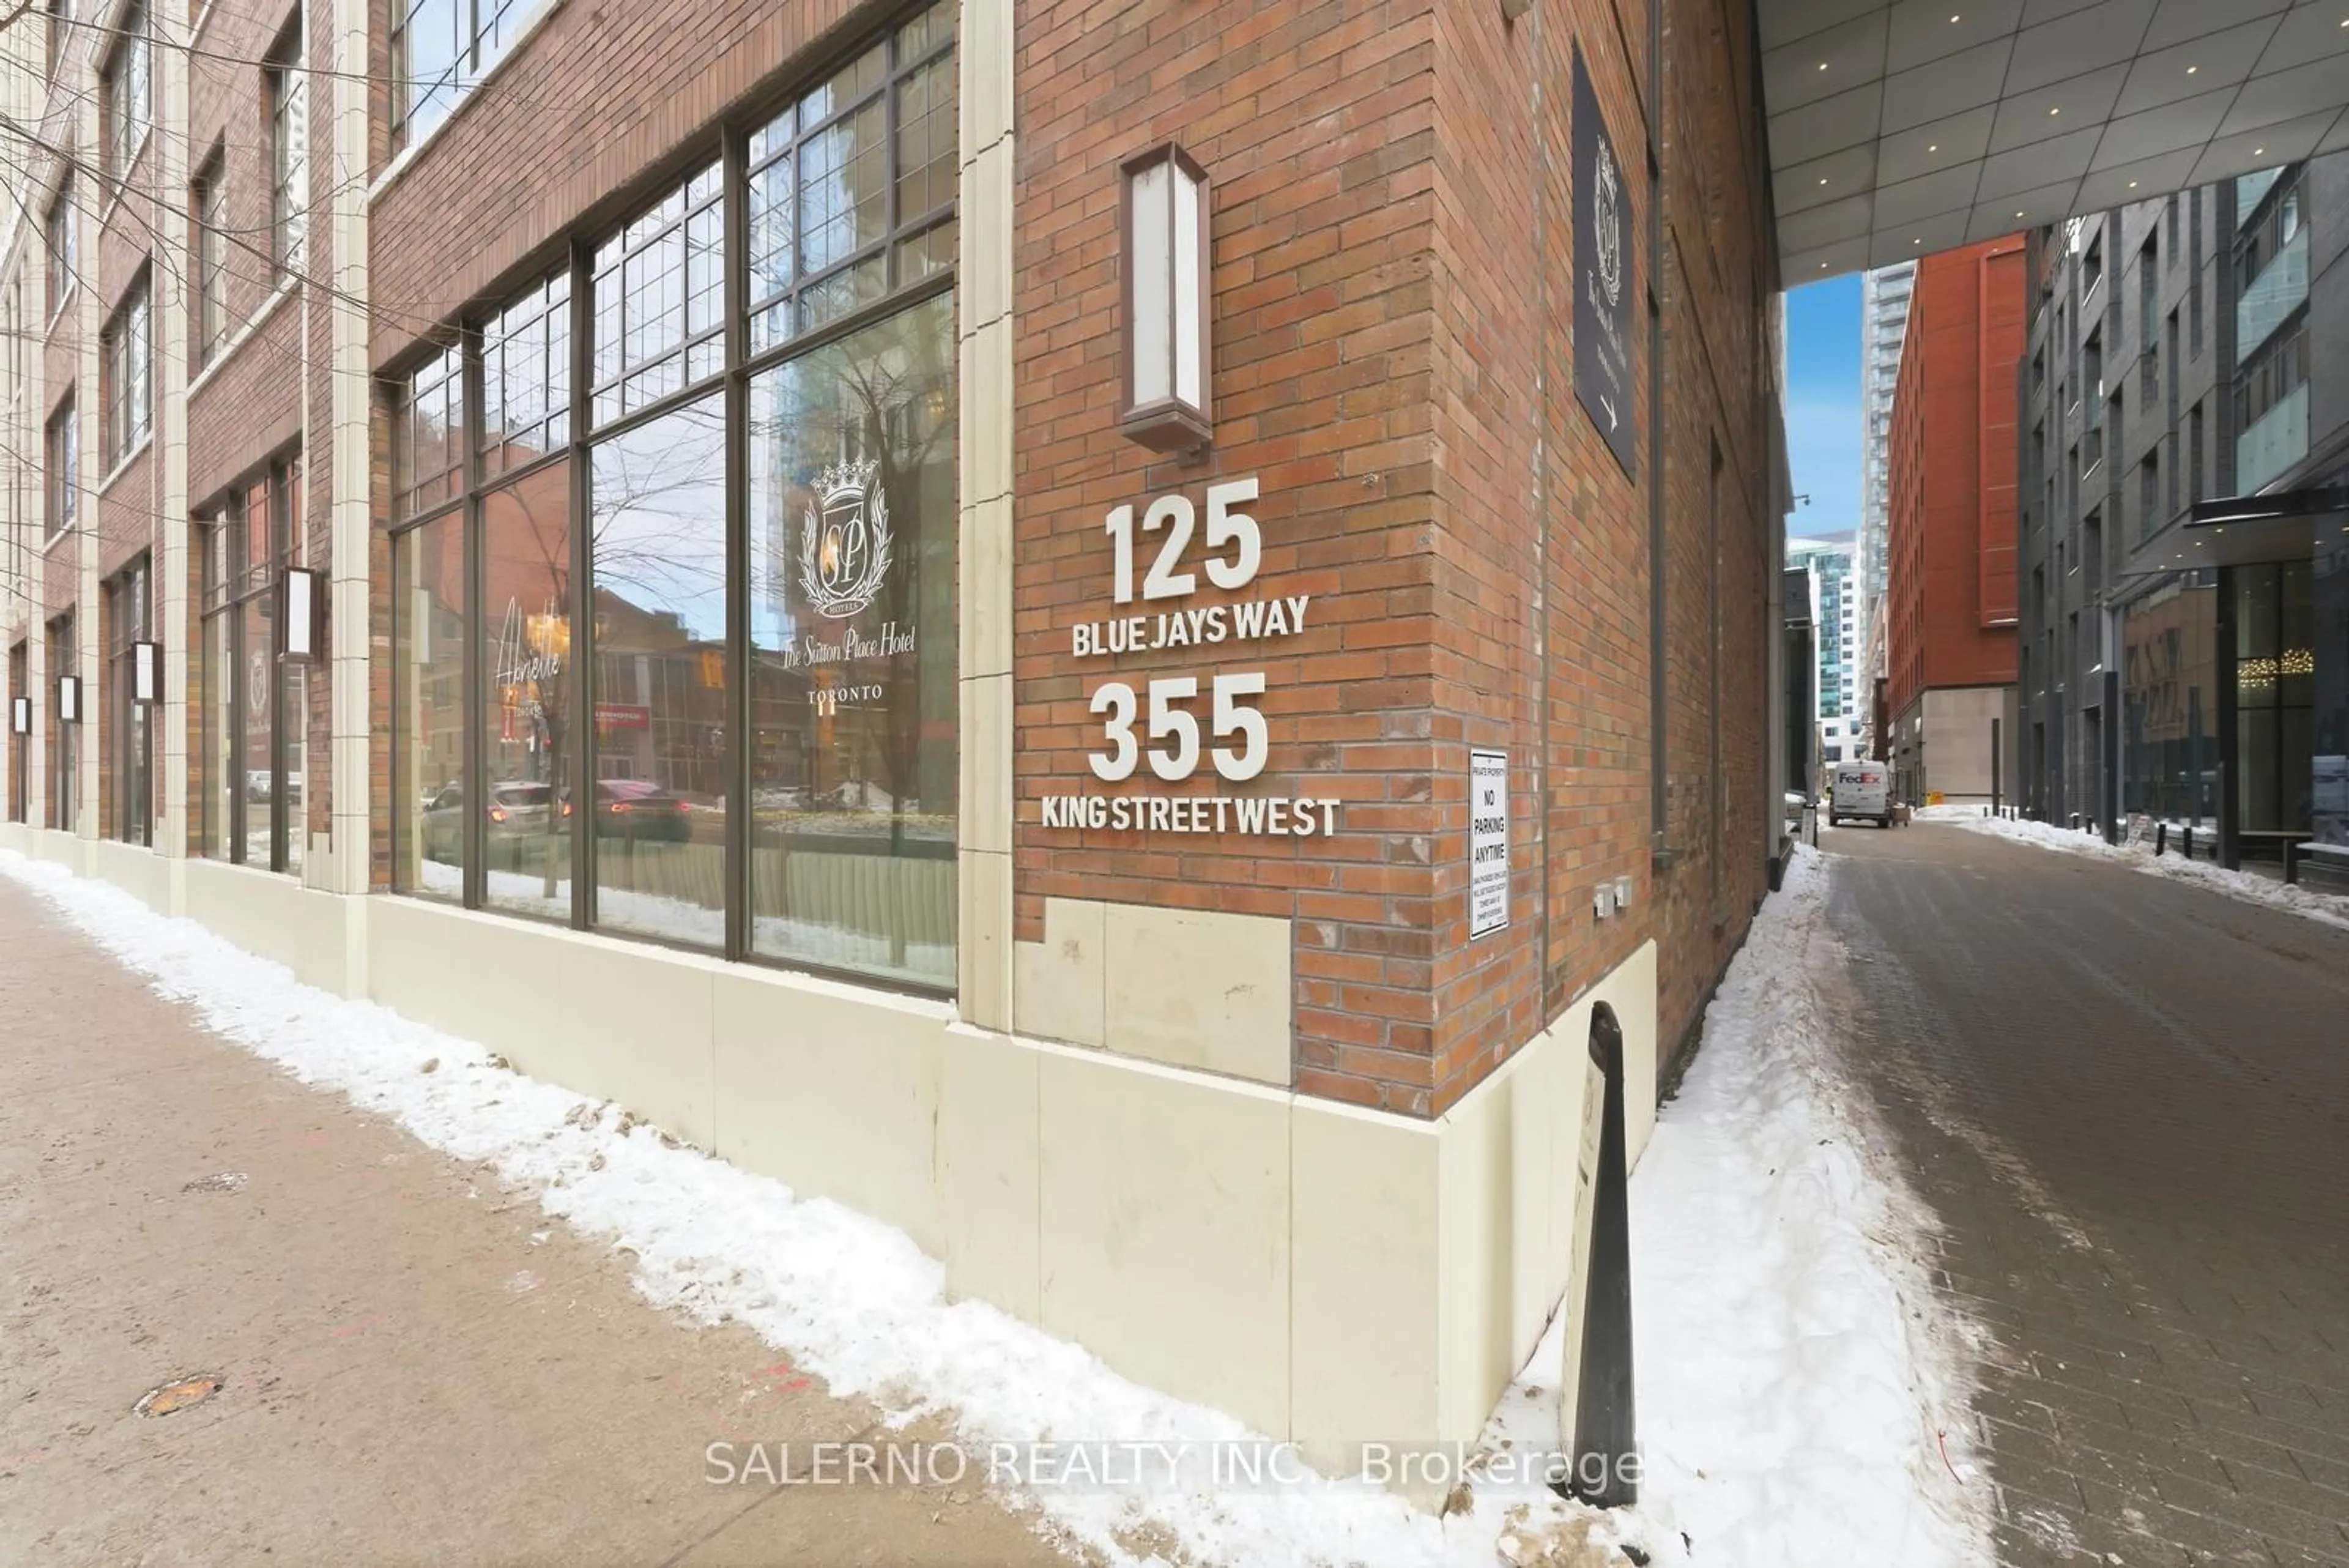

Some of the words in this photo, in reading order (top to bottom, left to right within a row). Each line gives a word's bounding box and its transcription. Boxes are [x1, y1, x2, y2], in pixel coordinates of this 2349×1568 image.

[1105, 477, 1261, 604] 125
[829, 602, 858, 614] HOTELS
[1072, 617, 1146, 657] BLUE
[1150, 606, 1227, 650] JAYS
[1234, 595, 1310, 640] WAY
[784, 635, 801, 669] The
[803, 634, 841, 666] Sutton
[843, 624, 878, 661] Place
[879, 621, 916, 657] Hotel
[807, 683, 882, 704] TORONTO
[1088, 672, 1269, 782] 355
[1839, 772, 1880, 784] FedEx
[1484, 789, 1495, 806] NO
[1042, 797, 1106, 829] KING
[1111, 797, 1232, 833] STREET
[1234, 798, 1341, 837] WEST
[1474, 817, 1504, 835] PARKING
[1475, 844, 1504, 864] ANYTIME
